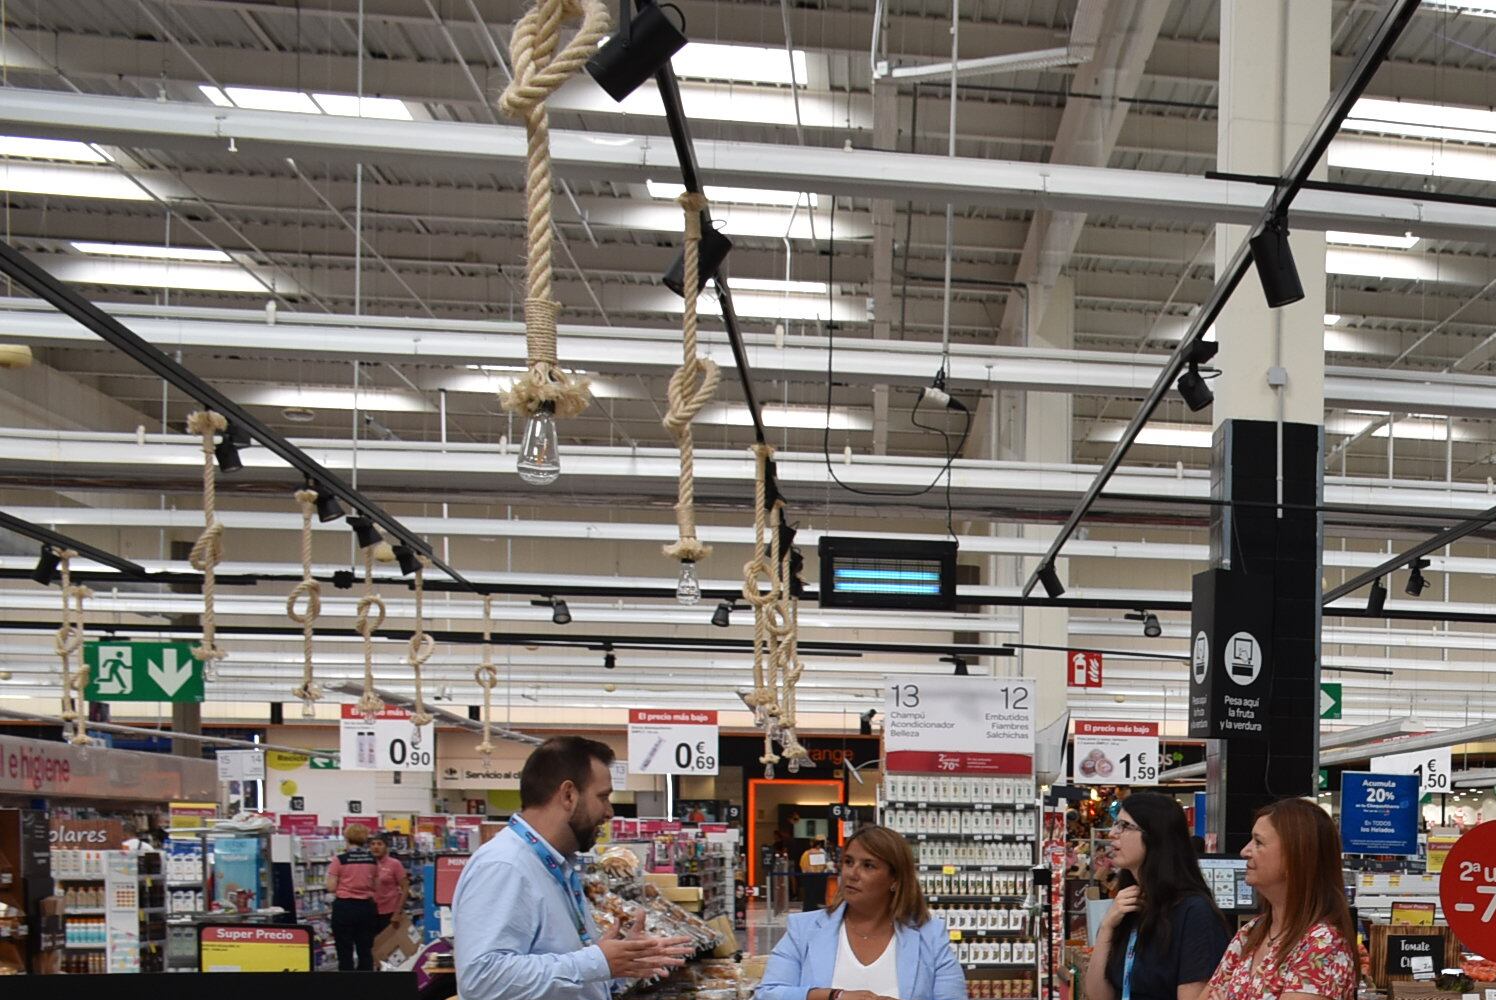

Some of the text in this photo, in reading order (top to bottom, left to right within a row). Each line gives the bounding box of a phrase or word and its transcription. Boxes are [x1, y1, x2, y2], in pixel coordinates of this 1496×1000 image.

[891, 684, 920, 708] 13
[1000, 686, 1029, 710] 12
[1224, 695, 1260, 709] Pesa aquí
[890, 711, 926, 721] Champú
[985, 712, 1029, 722] Embutidos
[1228, 707, 1255, 719] la fruta
[890, 719, 956, 730] Acondicionador
[991, 721, 1029, 731] Fiambres
[1083, 722, 1150, 735] El precio más bajo
[1225, 719, 1262, 732] la verdura
[890, 729, 920, 738] Belleza
[985, 730, 1029, 740] Salchichas
[20, 746, 71, 789] higiene
[465, 770, 502, 780] Servicio
[1361, 779, 1397, 789] Acumula
[1366, 787, 1396, 803] 20%
[216, 927, 294, 942] Super Precio
[1400, 939, 1431, 952] Tomate
